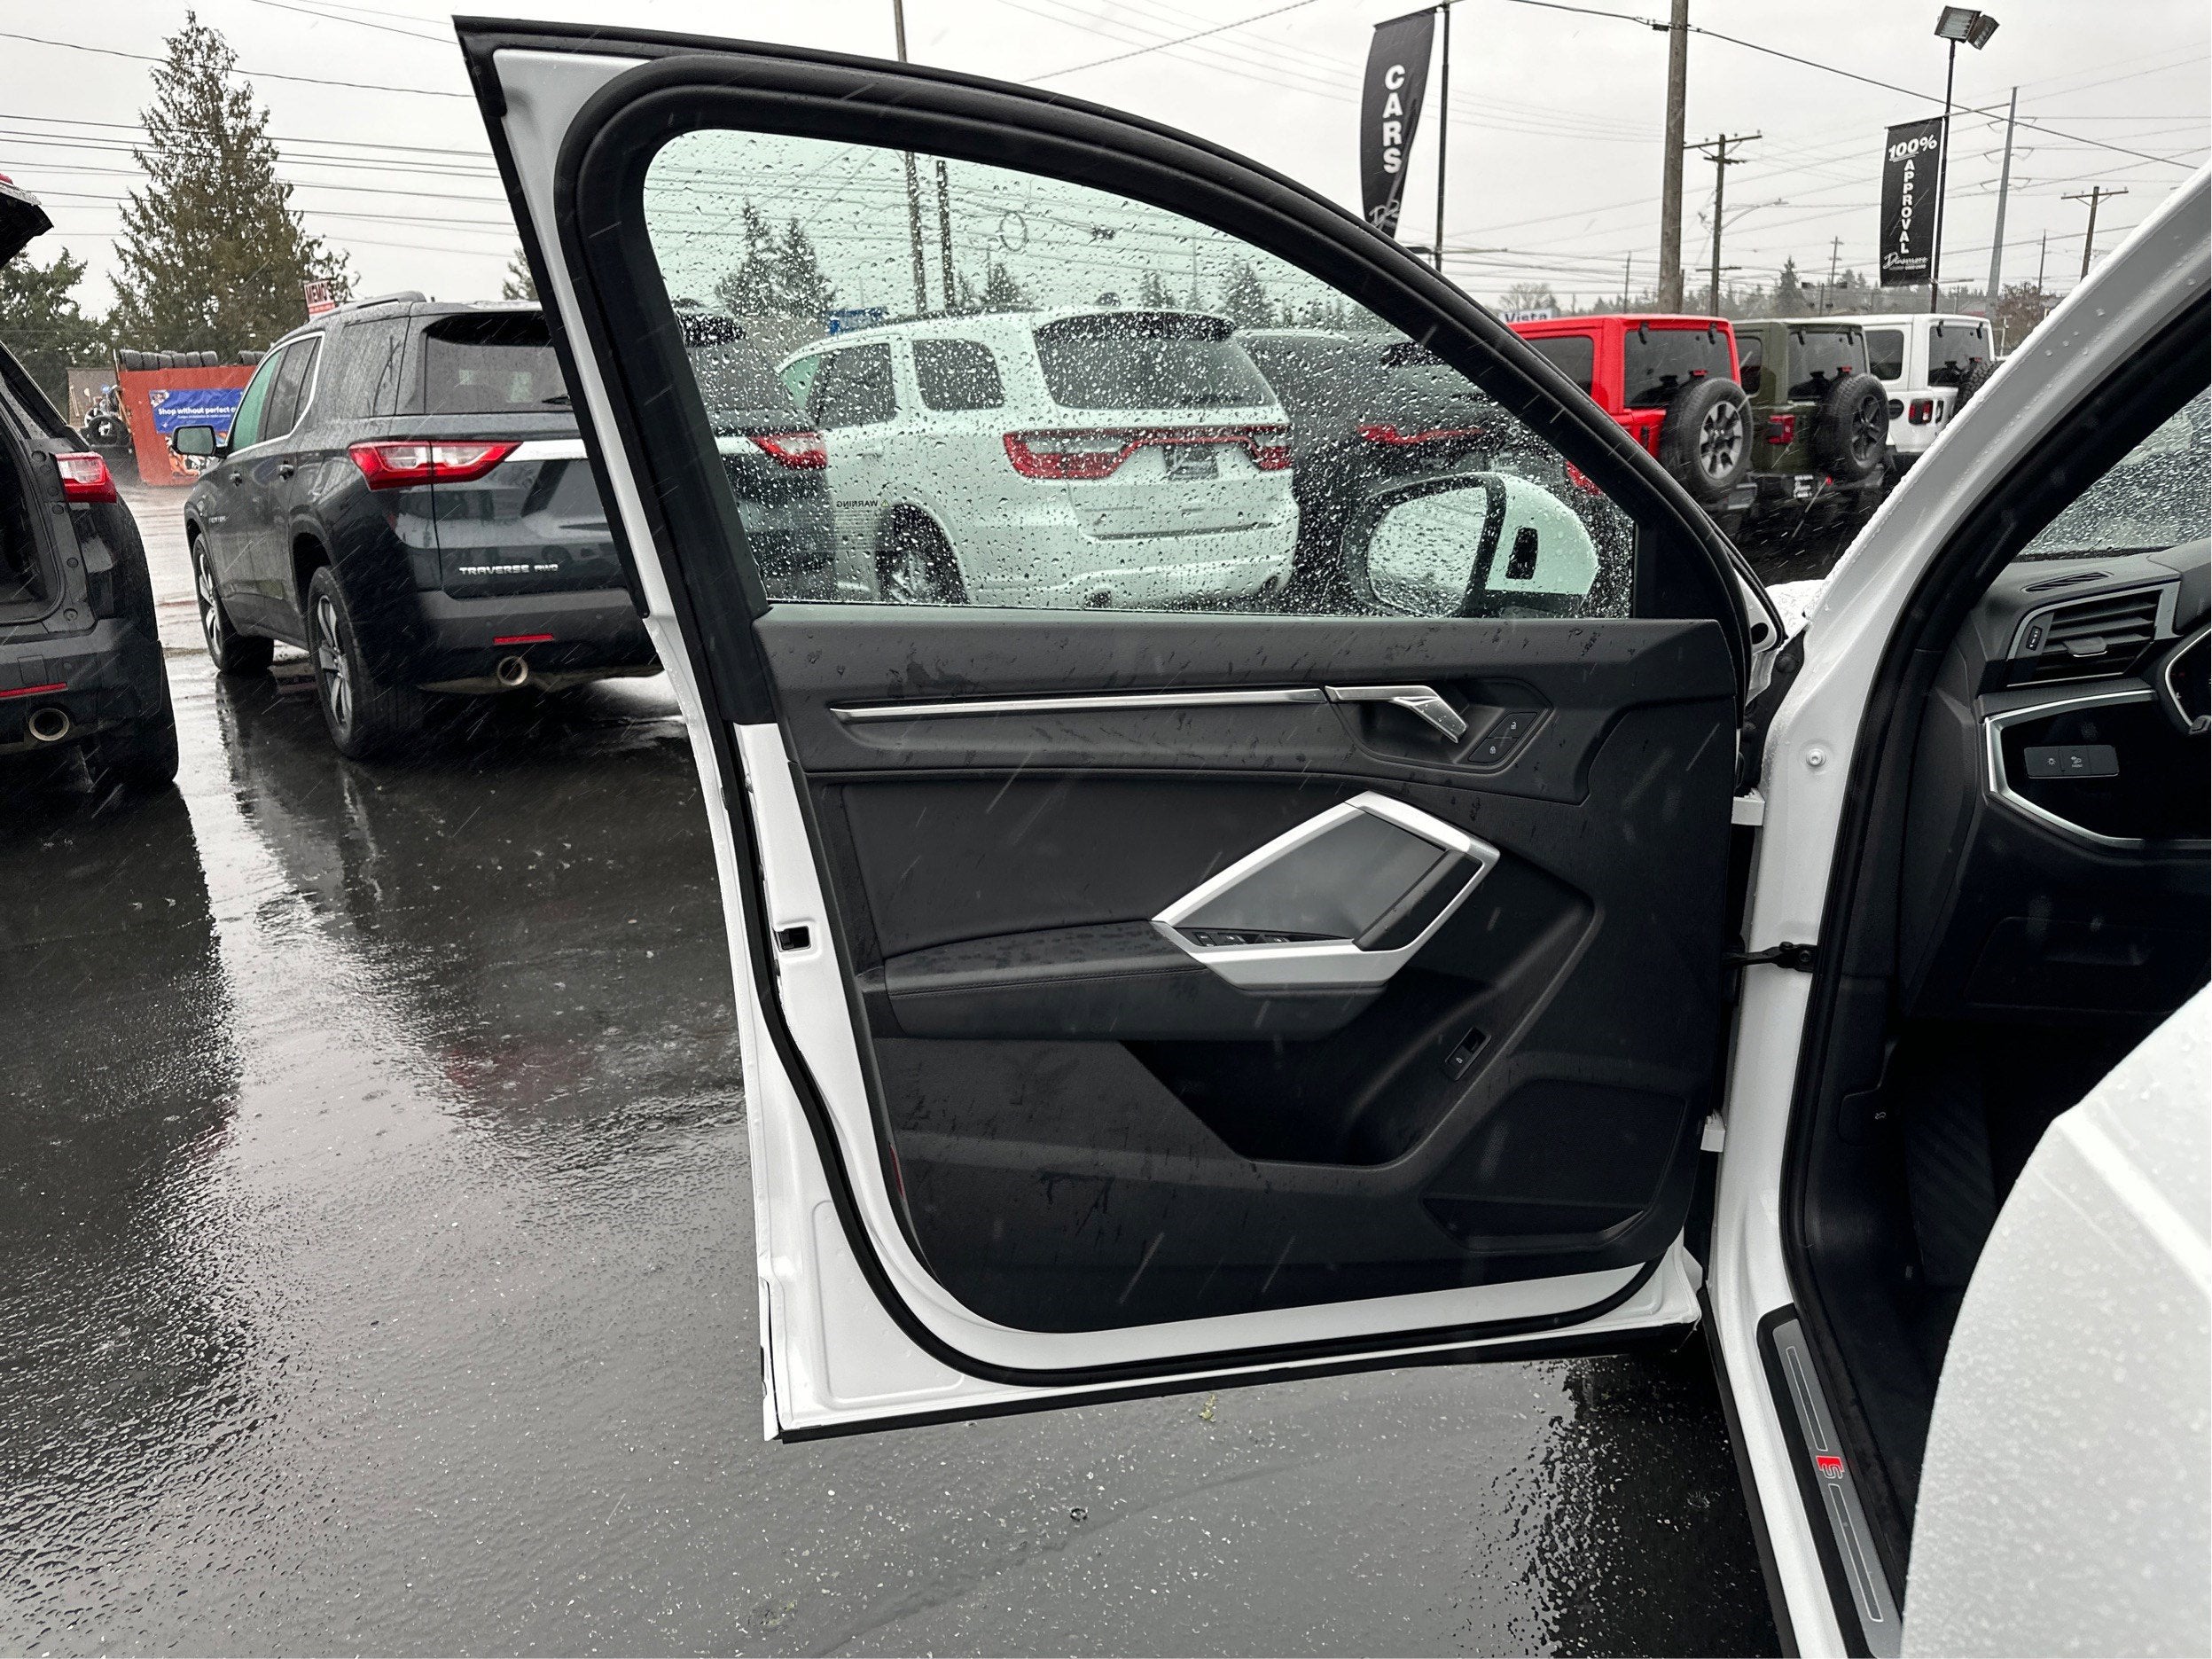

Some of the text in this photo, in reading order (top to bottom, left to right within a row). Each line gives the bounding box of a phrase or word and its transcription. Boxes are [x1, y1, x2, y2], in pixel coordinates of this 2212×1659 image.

[1382, 64, 1405, 174] CARS
[1888, 134, 1938, 160] 100%
[1899, 159, 1915, 254] APPROVAL
[458, 565, 530, 575] TRAVERSE
